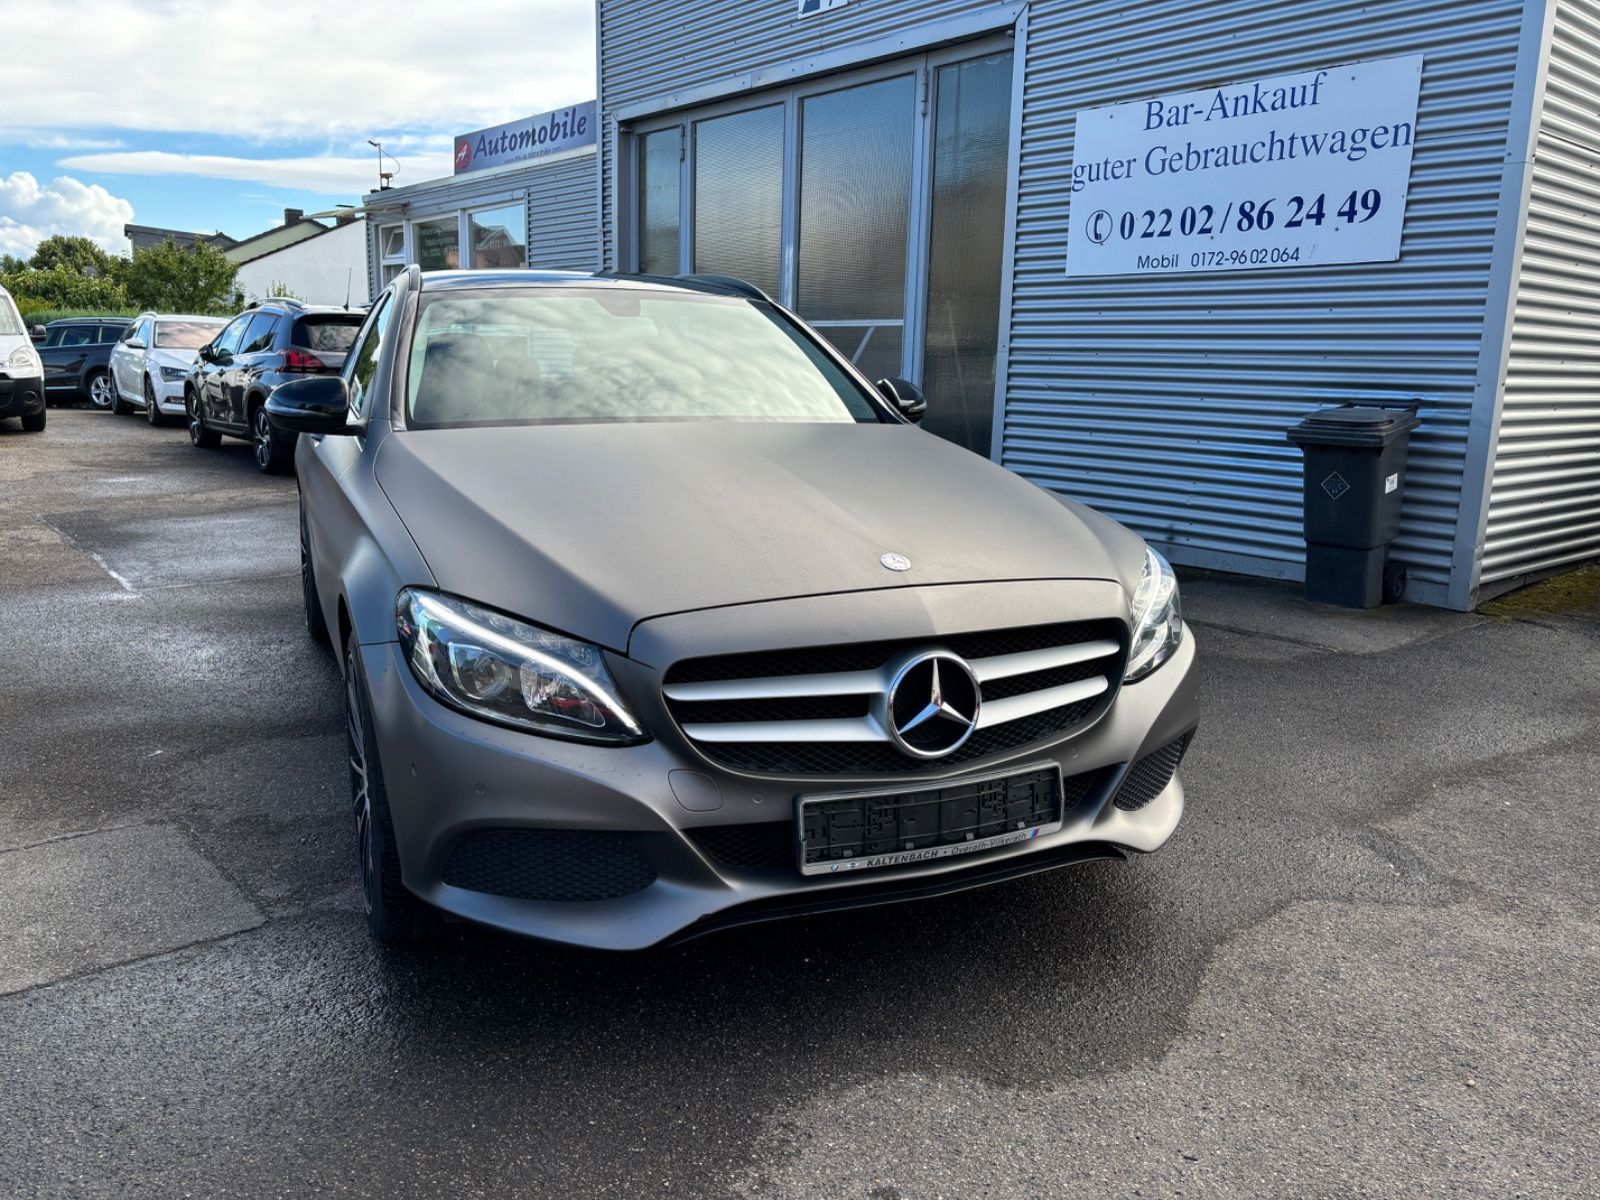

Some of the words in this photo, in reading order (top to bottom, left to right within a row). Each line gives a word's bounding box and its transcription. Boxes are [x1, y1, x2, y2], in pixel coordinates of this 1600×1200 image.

[1143, 71, 1328, 131] Bar-Ankauf
[473, 107, 587, 160] Automobile
[1071, 155, 1137, 193] guter
[1144, 121, 1413, 176] Gebrauchtwagen
[1136, 253, 1179, 269] Mobil
[866, 849, 939, 868] KALTENBACH
